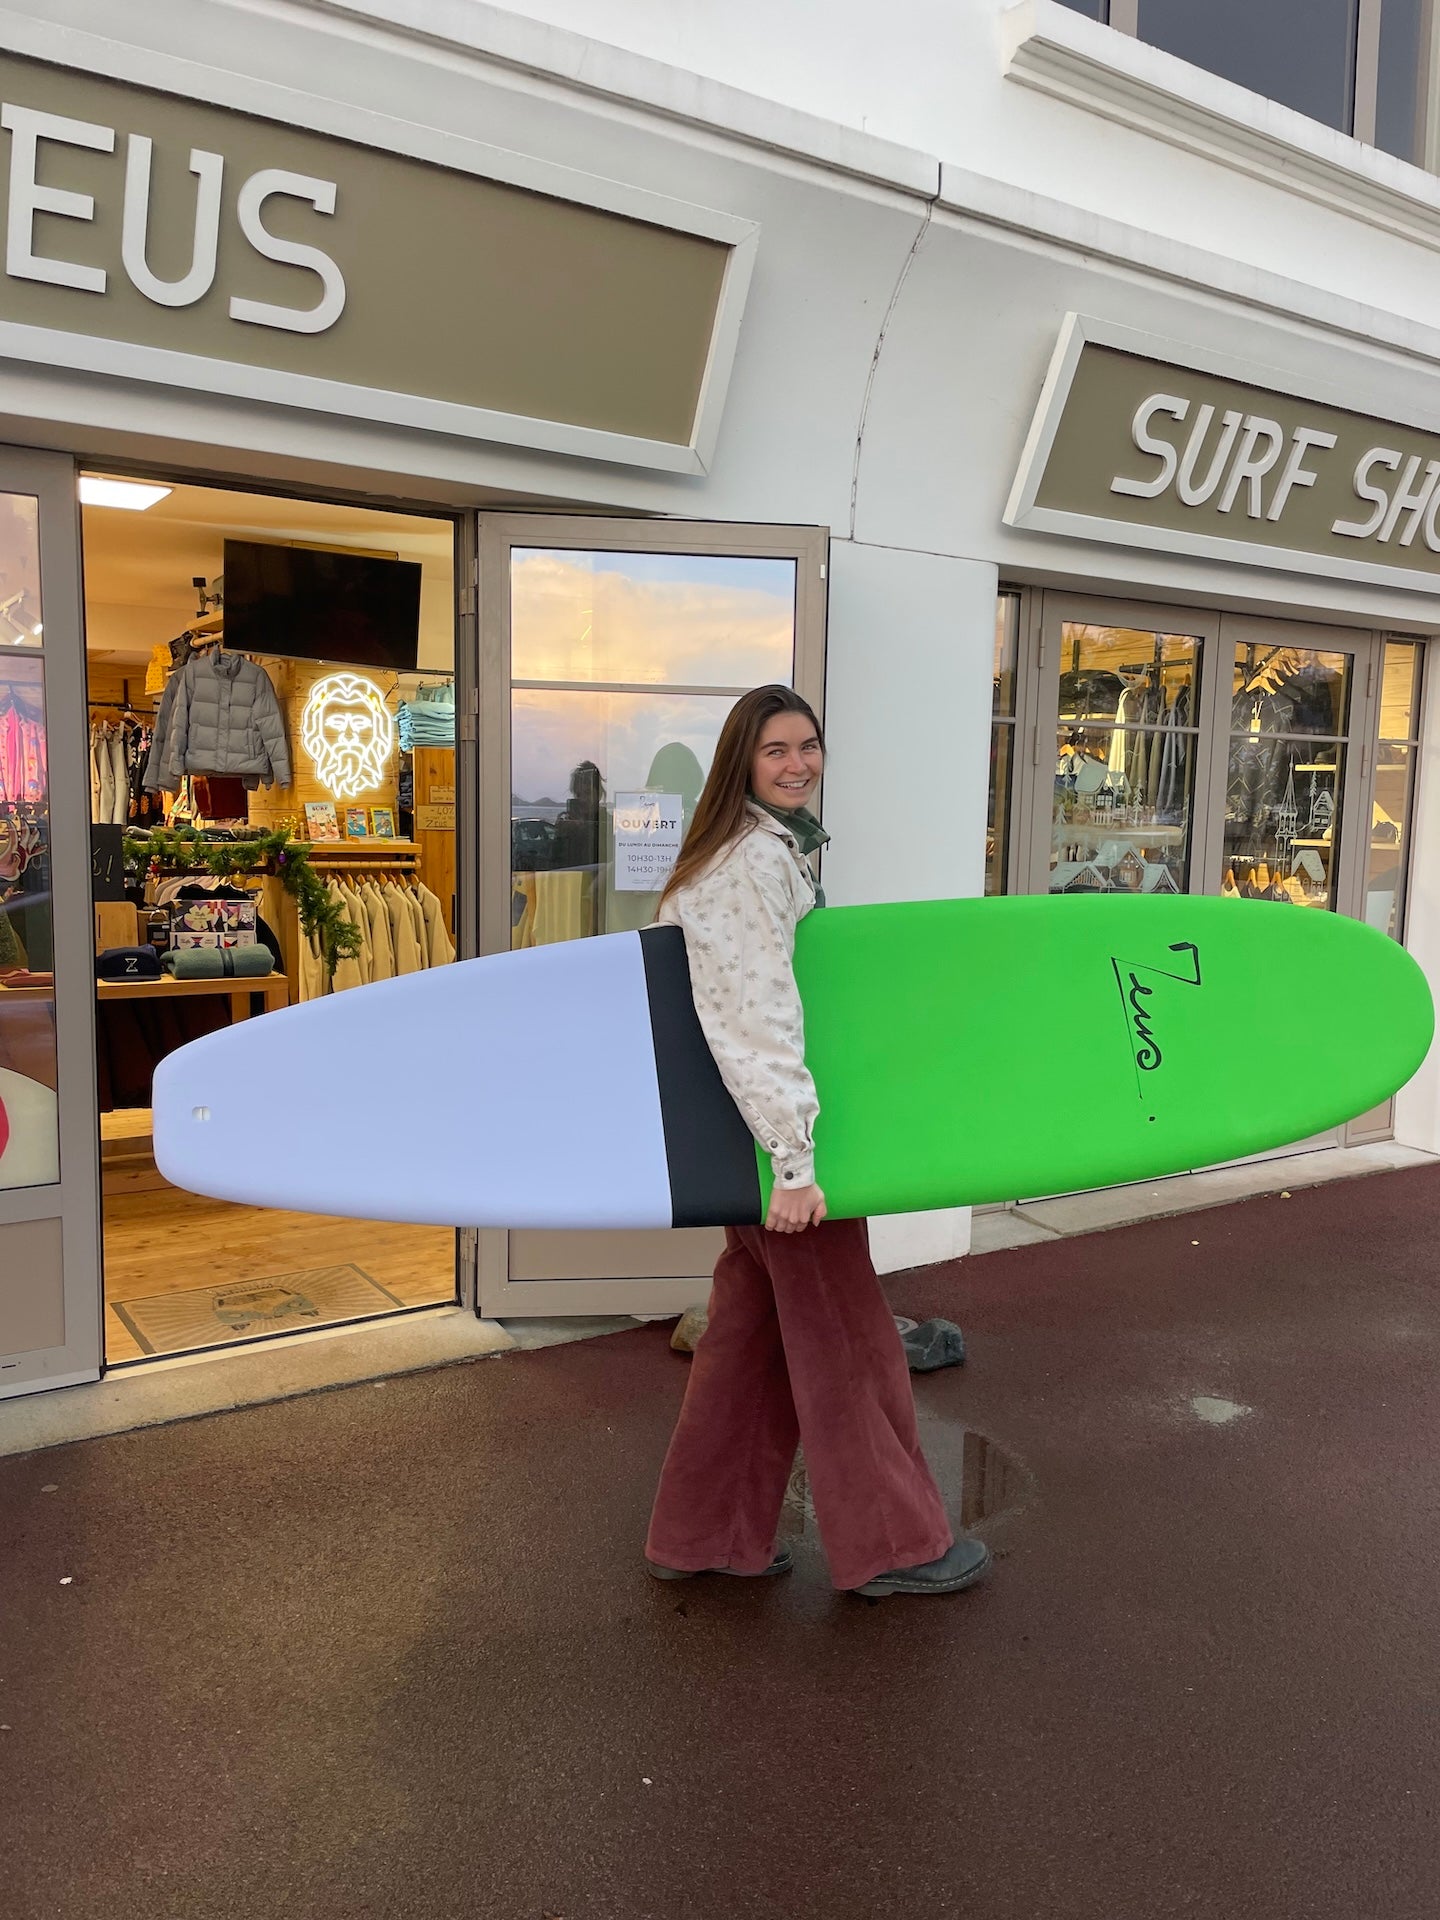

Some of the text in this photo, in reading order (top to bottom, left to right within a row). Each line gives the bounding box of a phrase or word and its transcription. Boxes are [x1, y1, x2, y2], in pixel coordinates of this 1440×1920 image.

[1, 103, 346, 334] EUS
[1110, 393, 1338, 521] SURF
[621, 819, 677, 829] OUVERT
[627, 854, 672, 862] 10H30-13H
